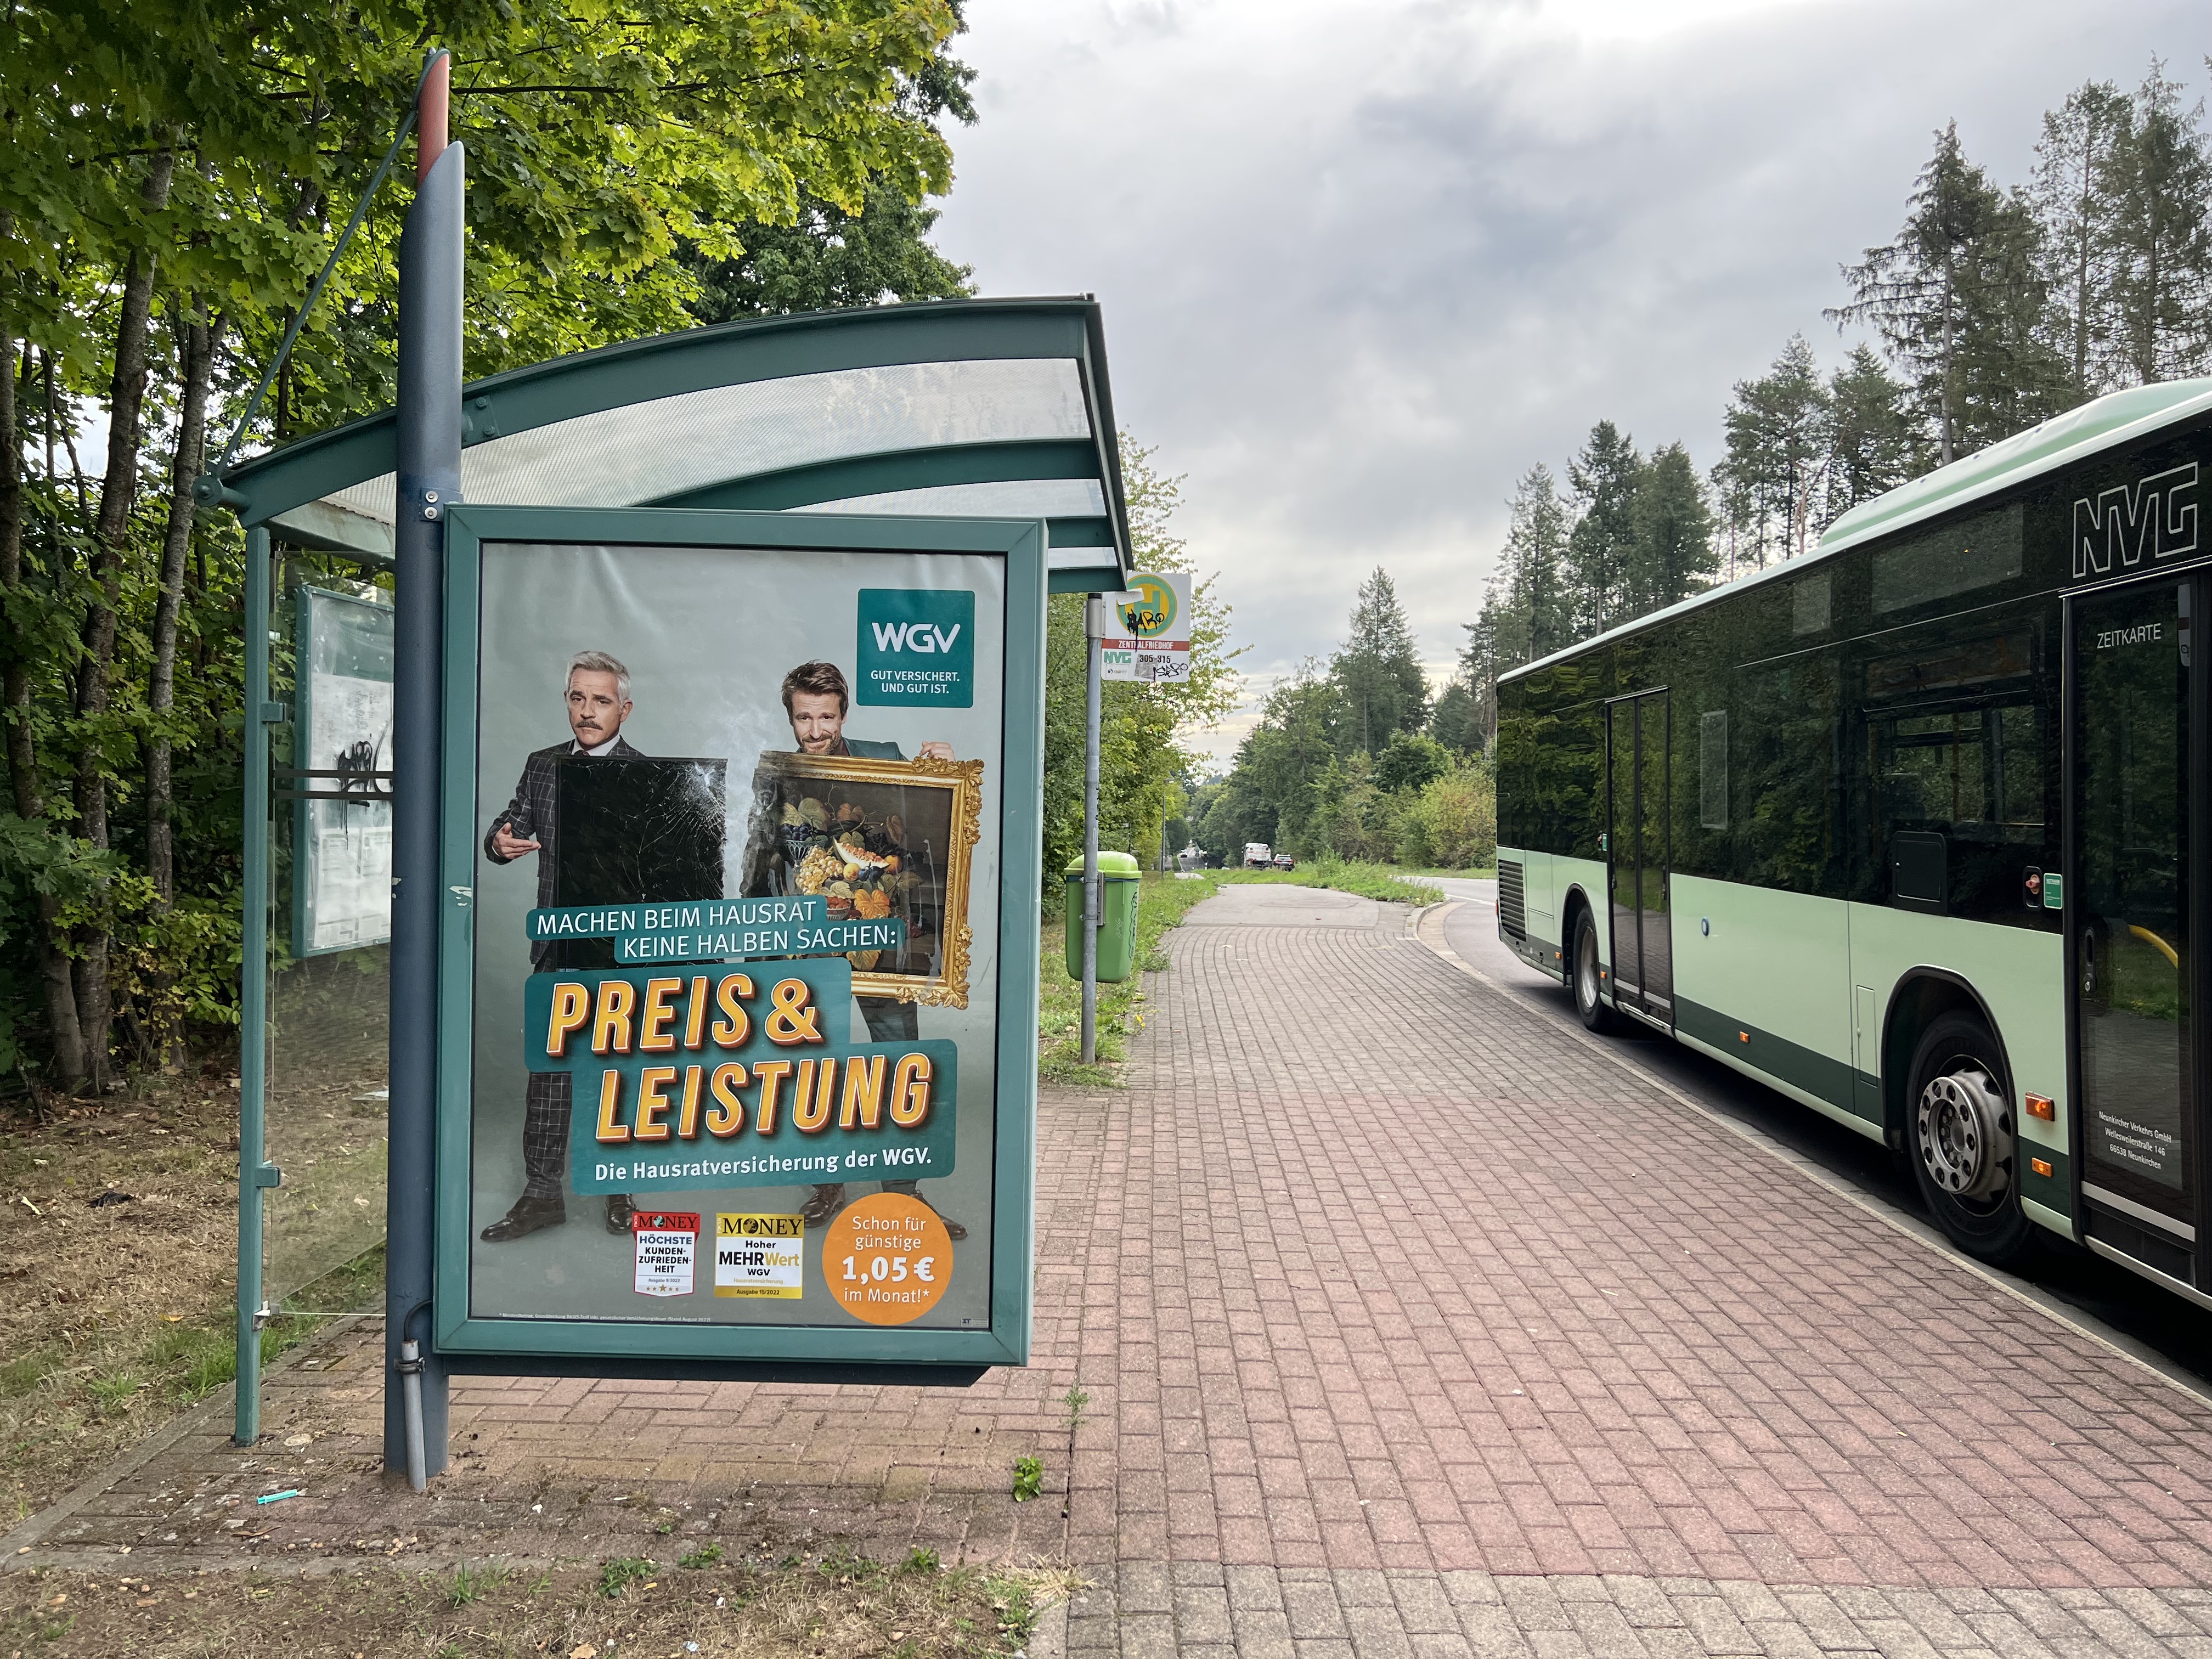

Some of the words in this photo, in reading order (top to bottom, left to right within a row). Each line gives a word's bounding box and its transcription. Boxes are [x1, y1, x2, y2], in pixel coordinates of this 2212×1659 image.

[2073, 461, 2198, 578] NVG
[871, 622, 961, 653] WGV
[2097, 623, 2162, 649] ZEITKARTE
[1104, 651, 1131, 664] NVG
[871, 670, 892, 680] GUT
[894, 670, 960, 682] VERSICHERT.
[881, 682, 904, 692] UND
[907, 683, 929, 693] GUT
[930, 684, 949, 693] IST.
[537, 910, 635, 935] MACHEN
[645, 907, 700, 929] BEIM
[709, 901, 817, 926] HAUSRAT
[624, 935, 689, 958] KEINE
[698, 929, 788, 955] HALBEN
[797, 924, 896, 950] SACHEN:
[546, 973, 755, 1058] PREIS
[765, 977, 825, 1047] &
[595, 1052, 934, 1144] LEISTUNG
[2098, 1110, 2129, 1128] Neunkircher
[2130, 1121, 2153, 1137] Verkehrs
[2154, 1130, 2171, 1143] GmbH
[2104, 1127, 2153, 1152] Wellesweilerstraße
[2154, 1145, 2165, 1156] 146
[595, 1163, 627, 1181] Die
[633, 1155, 839, 1179] Hausratversicherung
[845, 1150, 877, 1168] der
[882, 1147, 932, 1166] WGV.
[2109, 1143, 2127, 1157] 66538
[2128, 1149, 2162, 1170] Neunkirchen
[852, 1216, 900, 1231] Schon
[905, 1216, 926, 1232] für
[639, 1234, 692, 1245] HÖCHSTE
[645, 1246, 686, 1255] KUNDEN-
[746, 1240, 776, 1249] Hoher
[855, 1234, 922, 1252] günstige
[638, 1256, 692, 1264] ZUFRIEDEN-
[719, 1251, 799, 1267] MEHRWert
[842, 1256, 908, 1285] 1,05
[913, 1256, 935, 1283] €
[844, 1287, 862, 1302] im
